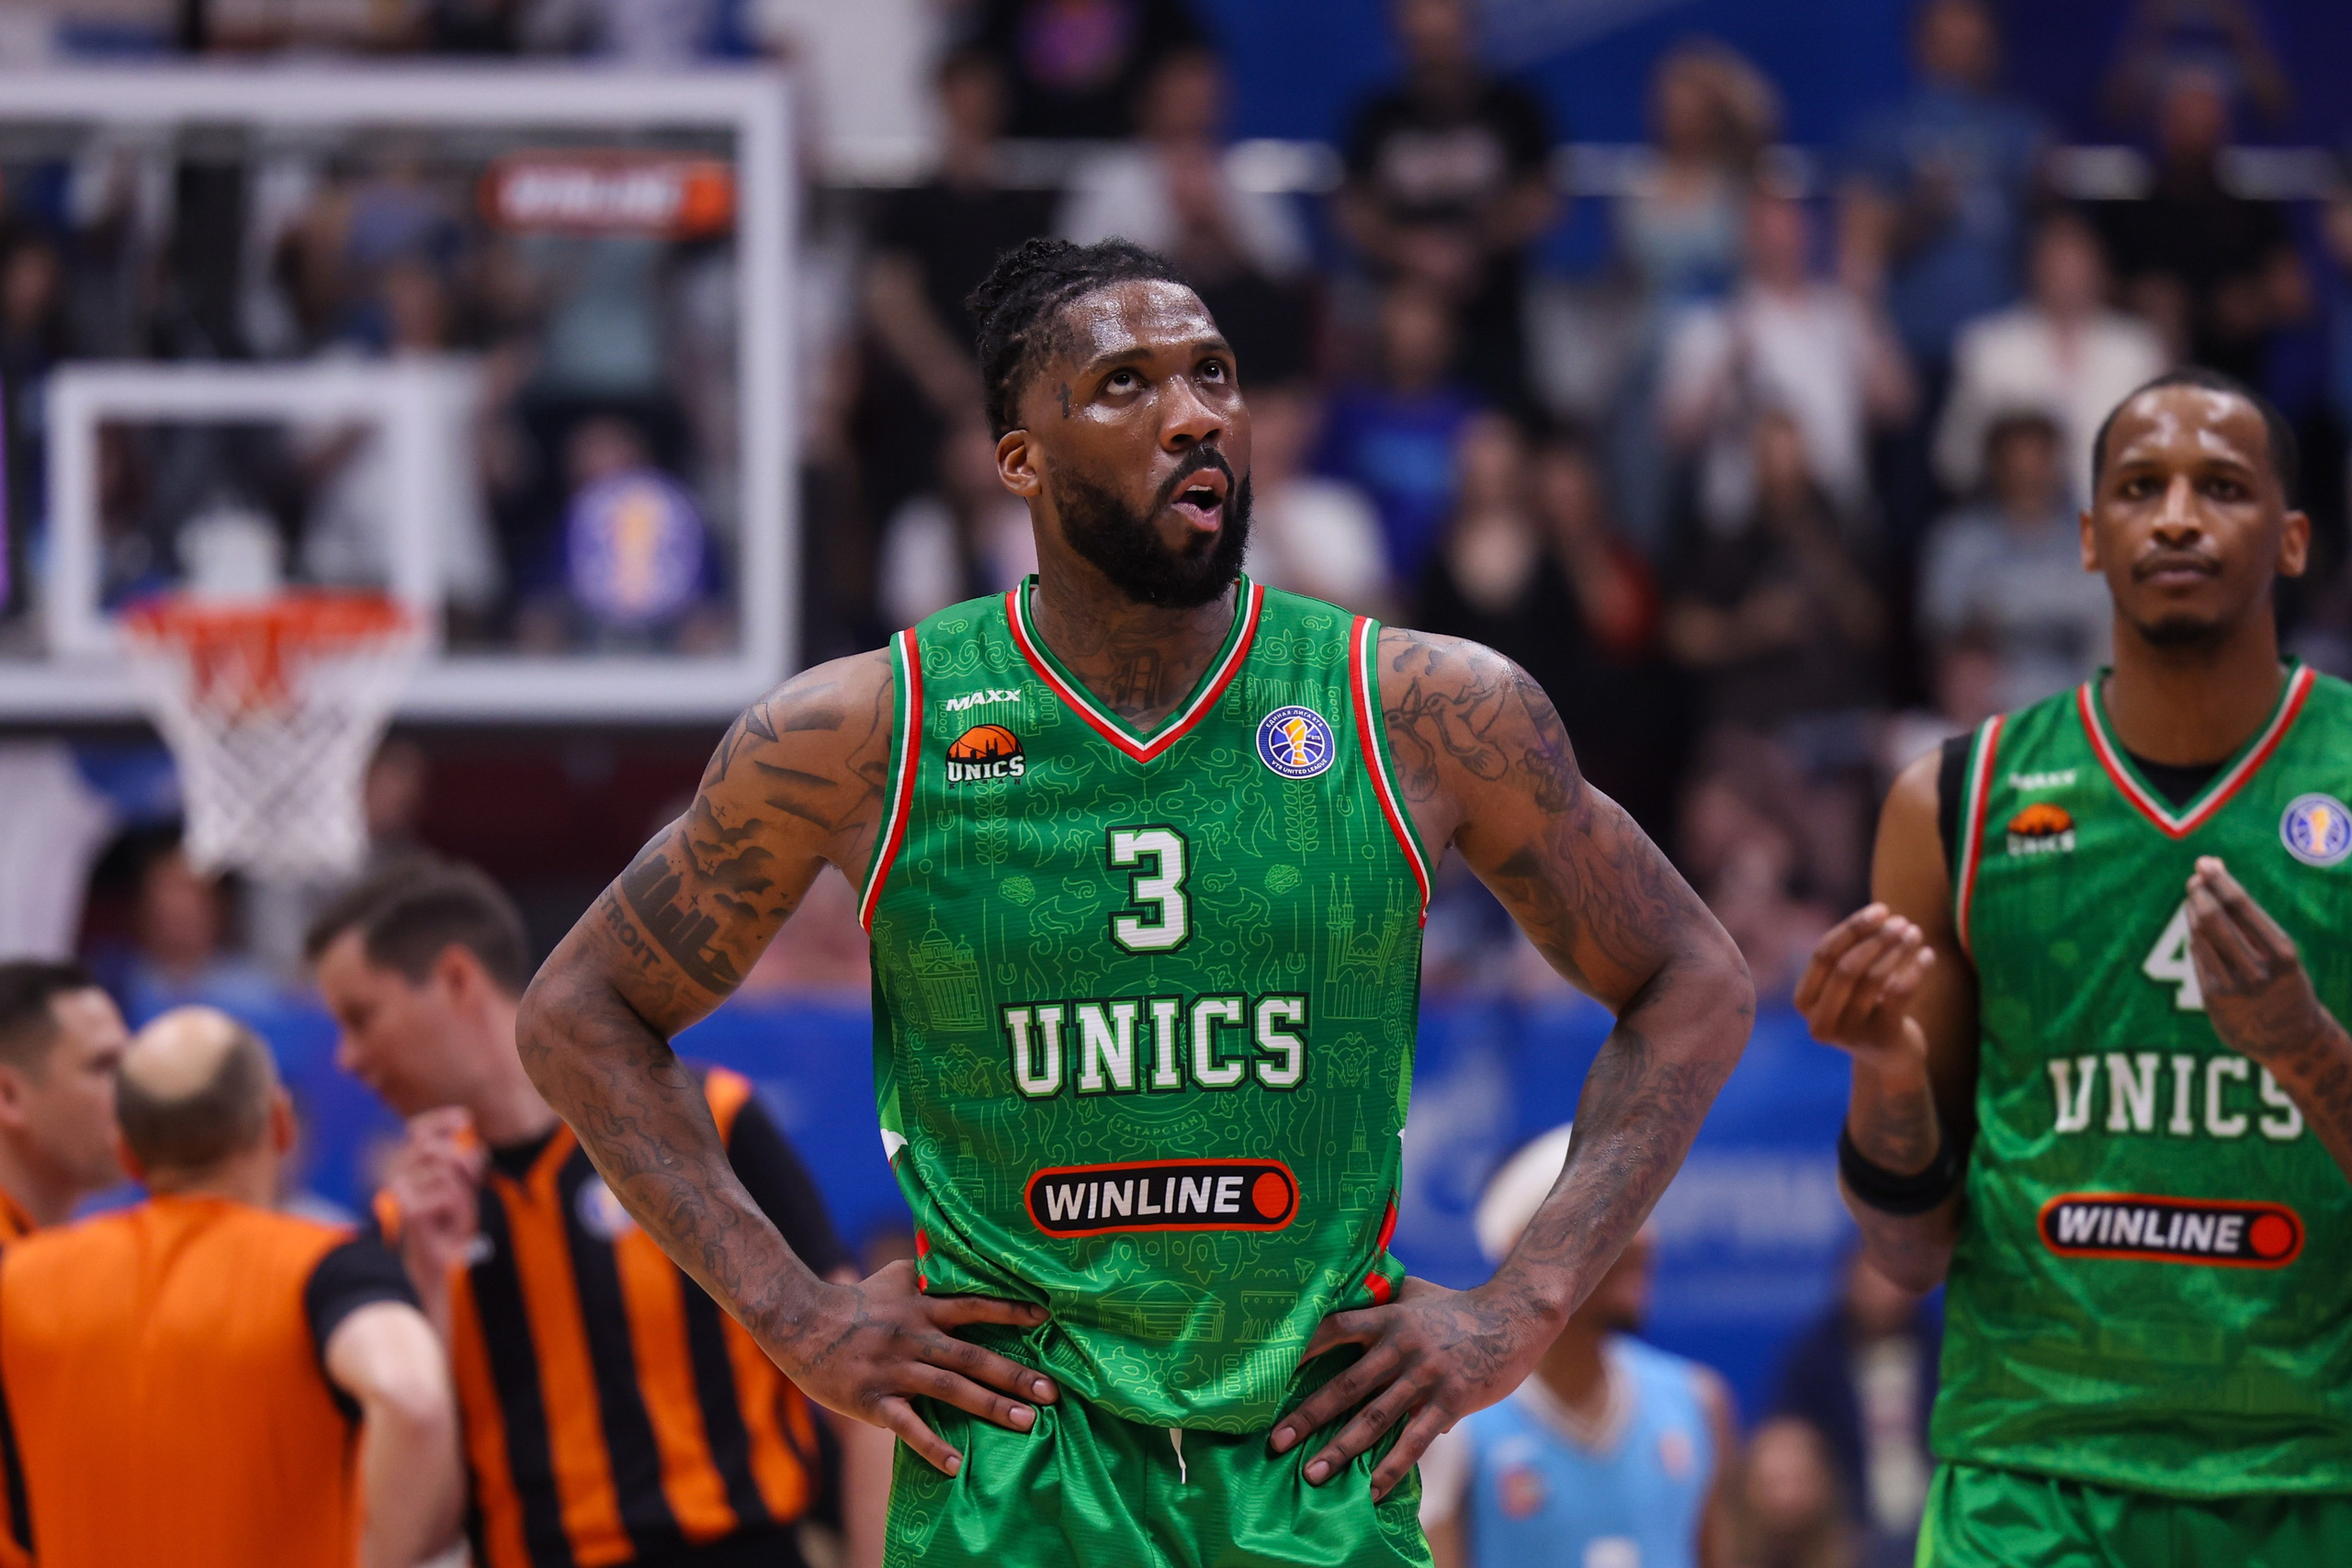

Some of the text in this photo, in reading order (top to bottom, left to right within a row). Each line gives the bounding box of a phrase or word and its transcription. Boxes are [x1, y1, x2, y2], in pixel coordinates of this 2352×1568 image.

[946, 689, 1022, 712] MAXX
[1265, 710, 1292, 728] ЕДИНАЯ
[1293, 709, 1311, 718] ЛИГА
[946, 754, 1025, 783] UNICS
[1272, 760, 1283, 770] VTB
[1306, 758, 1328, 773] LEAGUE
[1108, 826, 1191, 953] 3
[2141, 897, 2206, 1011] 4
[1001, 993, 1308, 1100] UNICS
[2047, 1053, 2303, 1141] UNICS
[1115, 1115, 1199, 1136] ТАТАРСТАН
[1045, 1175, 1245, 1223] WINLINE
[2058, 1205, 2244, 1253] WINLINE
